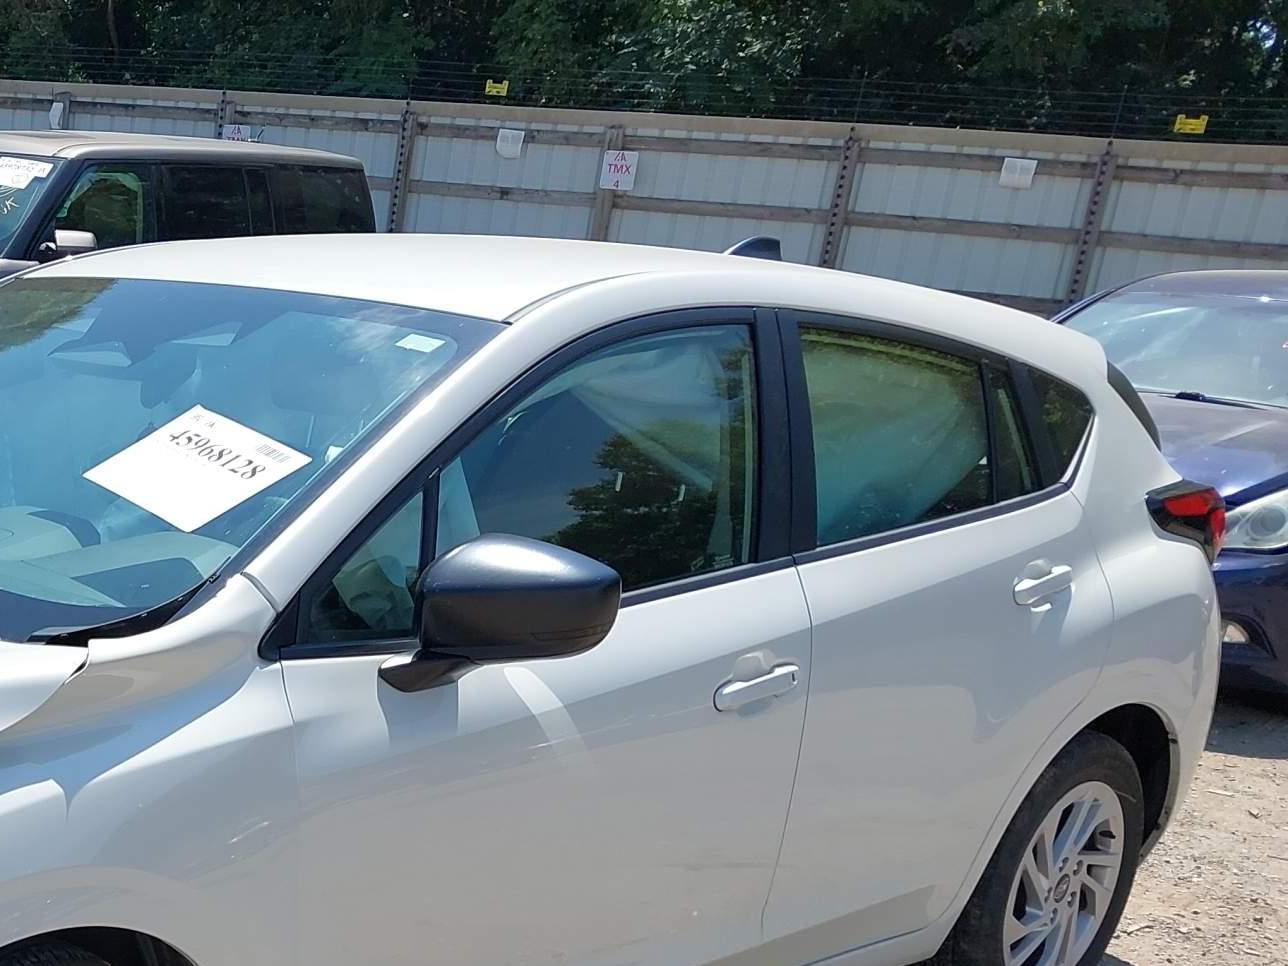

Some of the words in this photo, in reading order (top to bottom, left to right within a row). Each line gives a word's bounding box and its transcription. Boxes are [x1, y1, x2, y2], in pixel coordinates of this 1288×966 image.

[608, 163, 632, 175] TMX
[613, 180, 619, 188] 4
[169, 429, 266, 480] 45968128
